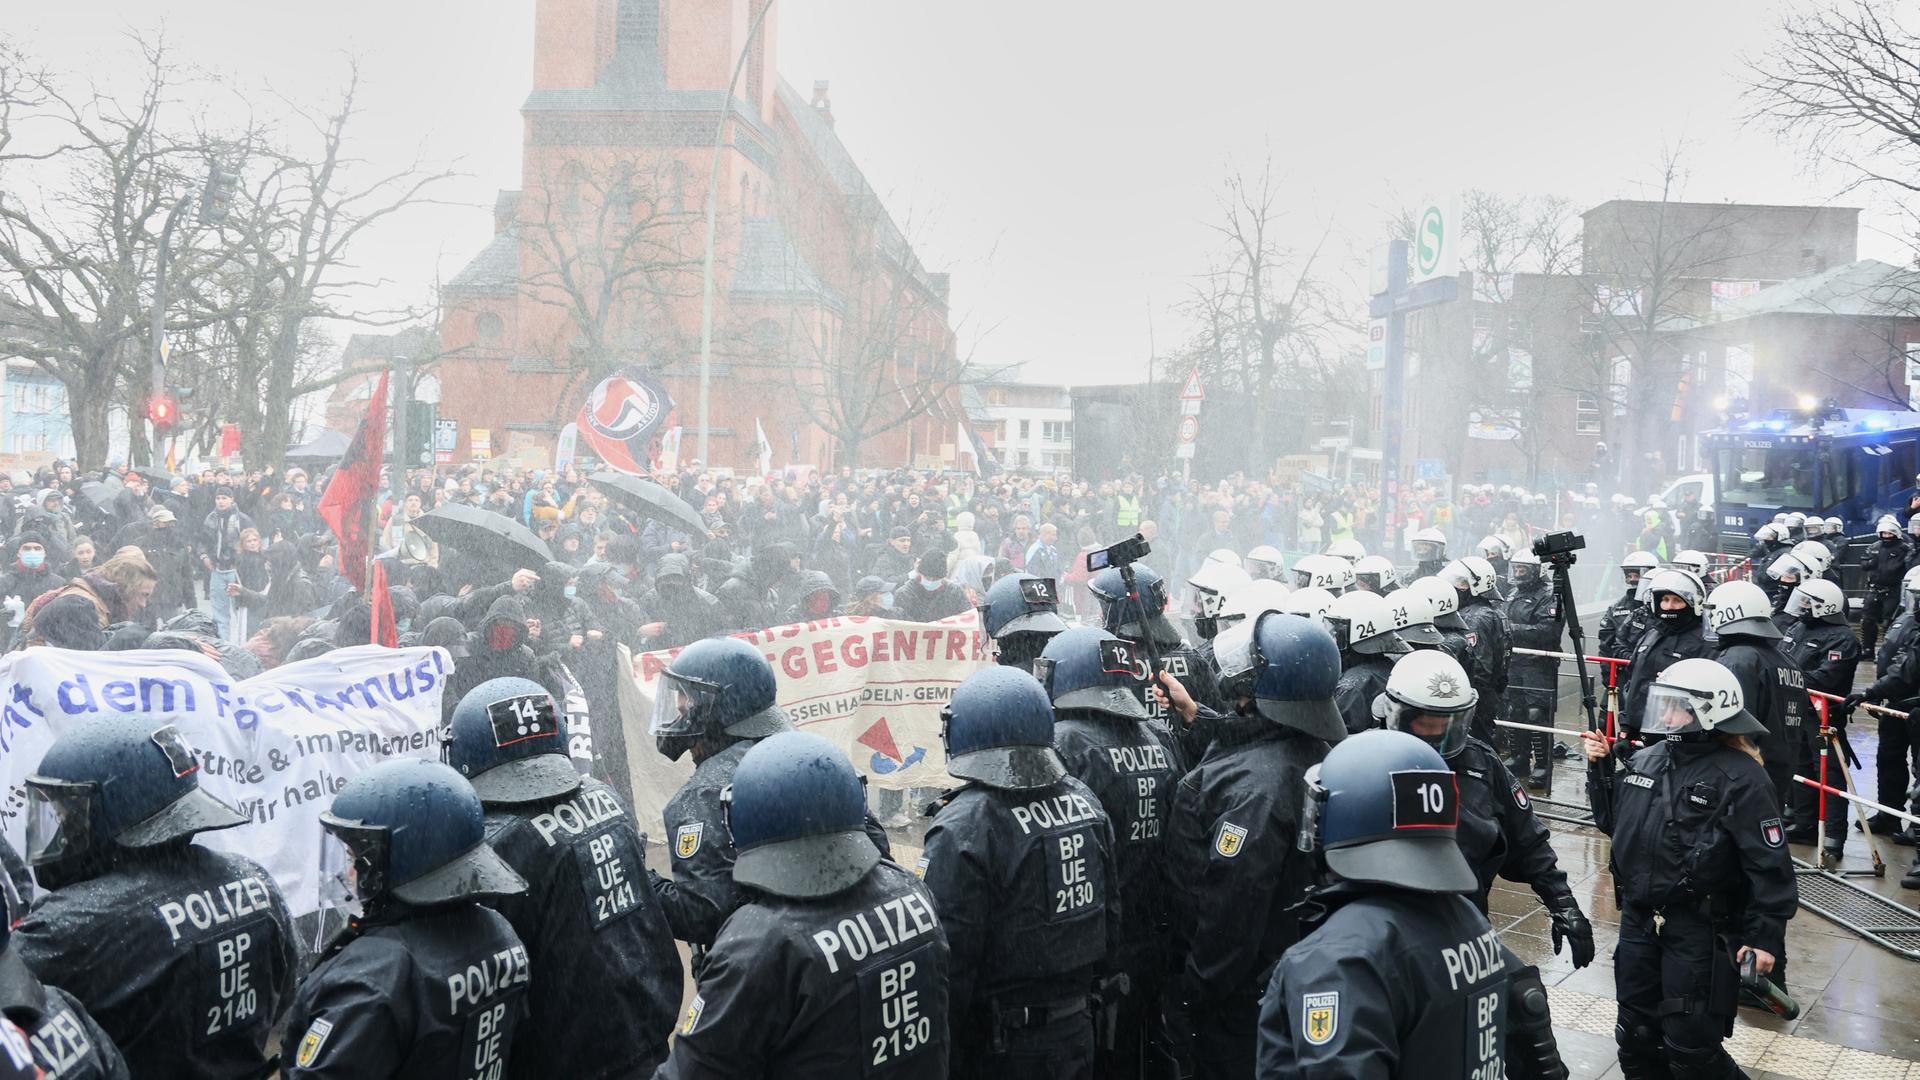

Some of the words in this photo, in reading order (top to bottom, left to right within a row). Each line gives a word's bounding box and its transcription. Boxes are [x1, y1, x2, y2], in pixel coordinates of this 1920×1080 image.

[436, 420, 457, 429] LICE
[1725, 516, 1736, 526] HH
[1737, 516, 1743, 526] 3
[1316, 574, 1334, 587] 24
[1342, 569, 1353, 582] 24
[1032, 583, 1048, 597] 12
[1392, 606, 1408, 620] 24
[1438, 598, 1453, 612] 24
[1717, 604, 1745, 625] 201
[1824, 603, 1836, 615] 32
[1356, 620, 1376, 639] 24
[1112, 646, 1129, 665] 12
[1133, 656, 1189, 681] OLZEI
[57, 673, 197, 716] dem
[1718, 690, 1739, 709] 24
[509, 698, 541, 725] 14
[791, 701, 831, 722] SSEN
[1146, 705, 1167, 718] UE
[190, 747, 265, 785] traße
[268, 748, 290, 773] &
[294, 733, 333, 758] im
[1109, 744, 1168, 773] POLIZEI
[1137, 777, 1156, 797] BP
[1624, 775, 1655, 789] POLIZEI
[1138, 799, 1156, 819] UE
[1417, 783, 1444, 814] 10
[530, 789, 625, 847] POLIZEI
[1011, 794, 1098, 835] POLIZEI
[1130, 820, 1160, 841] 2120
[1224, 824, 1246, 837] POLIZEI
[589, 833, 614, 865] BP
[1059, 833, 1084, 861] BP
[596, 858, 624, 890] UE
[1061, 858, 1086, 886] UE
[159, 876, 272, 941] POLIZEI
[596, 881, 636, 922] 2141
[1056, 881, 1094, 914] 2130
[812, 892, 938, 974] POLIZEI
[217, 932, 251, 970] BP
[220, 962, 251, 999] UE
[447, 945, 529, 1016] POLIZEI
[880, 960, 916, 1000] BP
[206, 988, 257, 1036] 2140
[882, 990, 920, 1030] UE
[1306, 996, 1336, 1008] POLIZEI
[1477, 992, 1499, 1029] BP
[477, 1003, 506, 1041] BP
[30, 1010, 91, 1080] IZEI
[474, 1032, 503, 1071] UE
[872, 1016, 931, 1066] 2130
[1479, 1025, 1498, 1062] UE
[468, 1058, 503, 1080] 40
